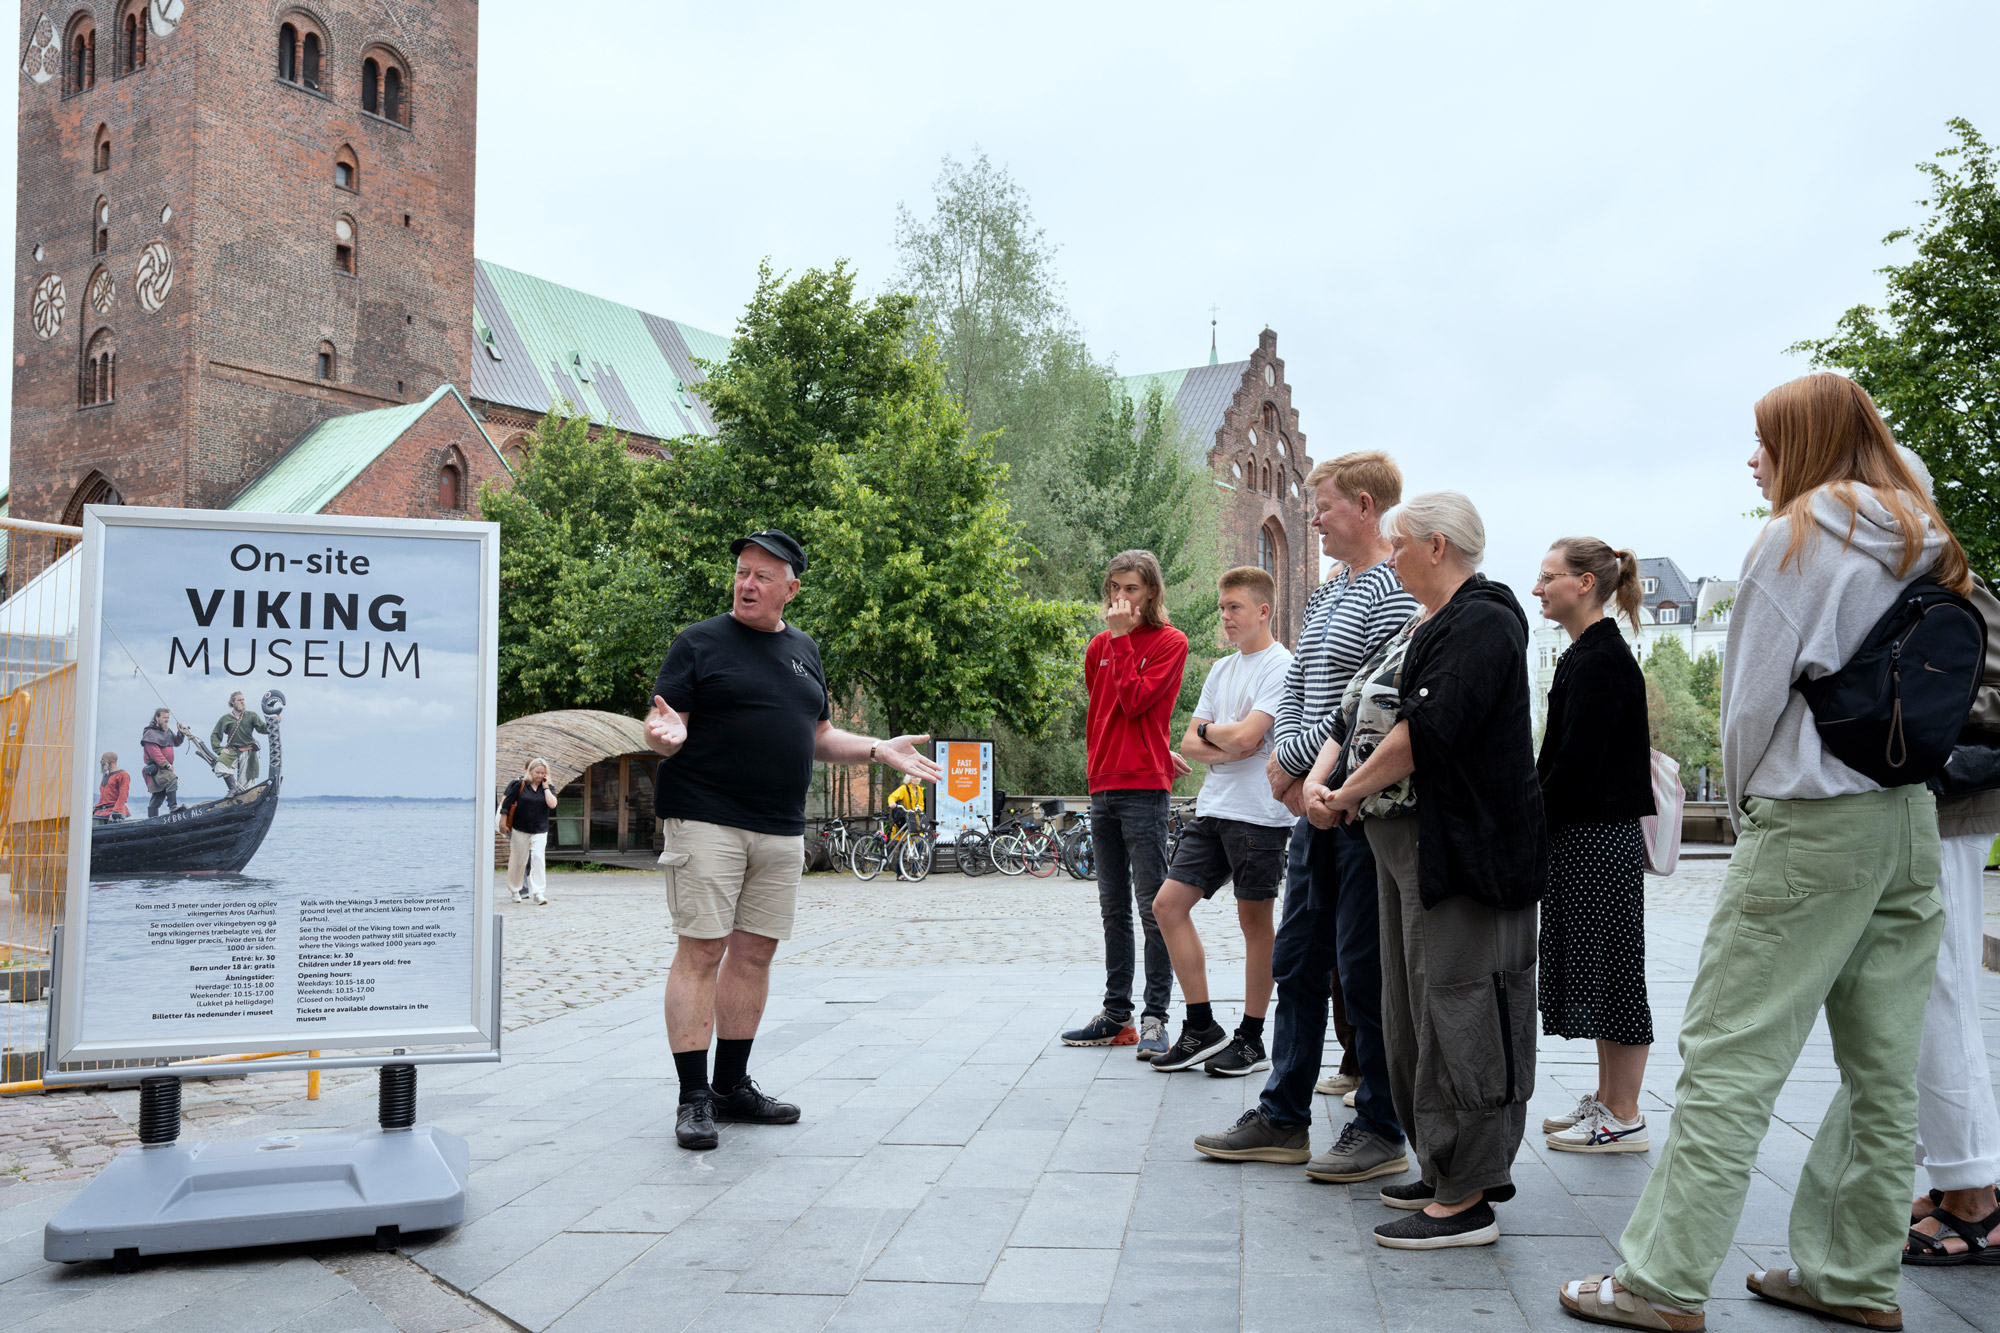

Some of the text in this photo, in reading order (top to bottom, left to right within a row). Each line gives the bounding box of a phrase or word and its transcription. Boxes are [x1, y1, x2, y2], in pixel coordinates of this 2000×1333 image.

[230, 544, 370, 575] On-site
[185, 588, 406, 632] VIKING
[168, 637, 420, 679] MUSEUM
